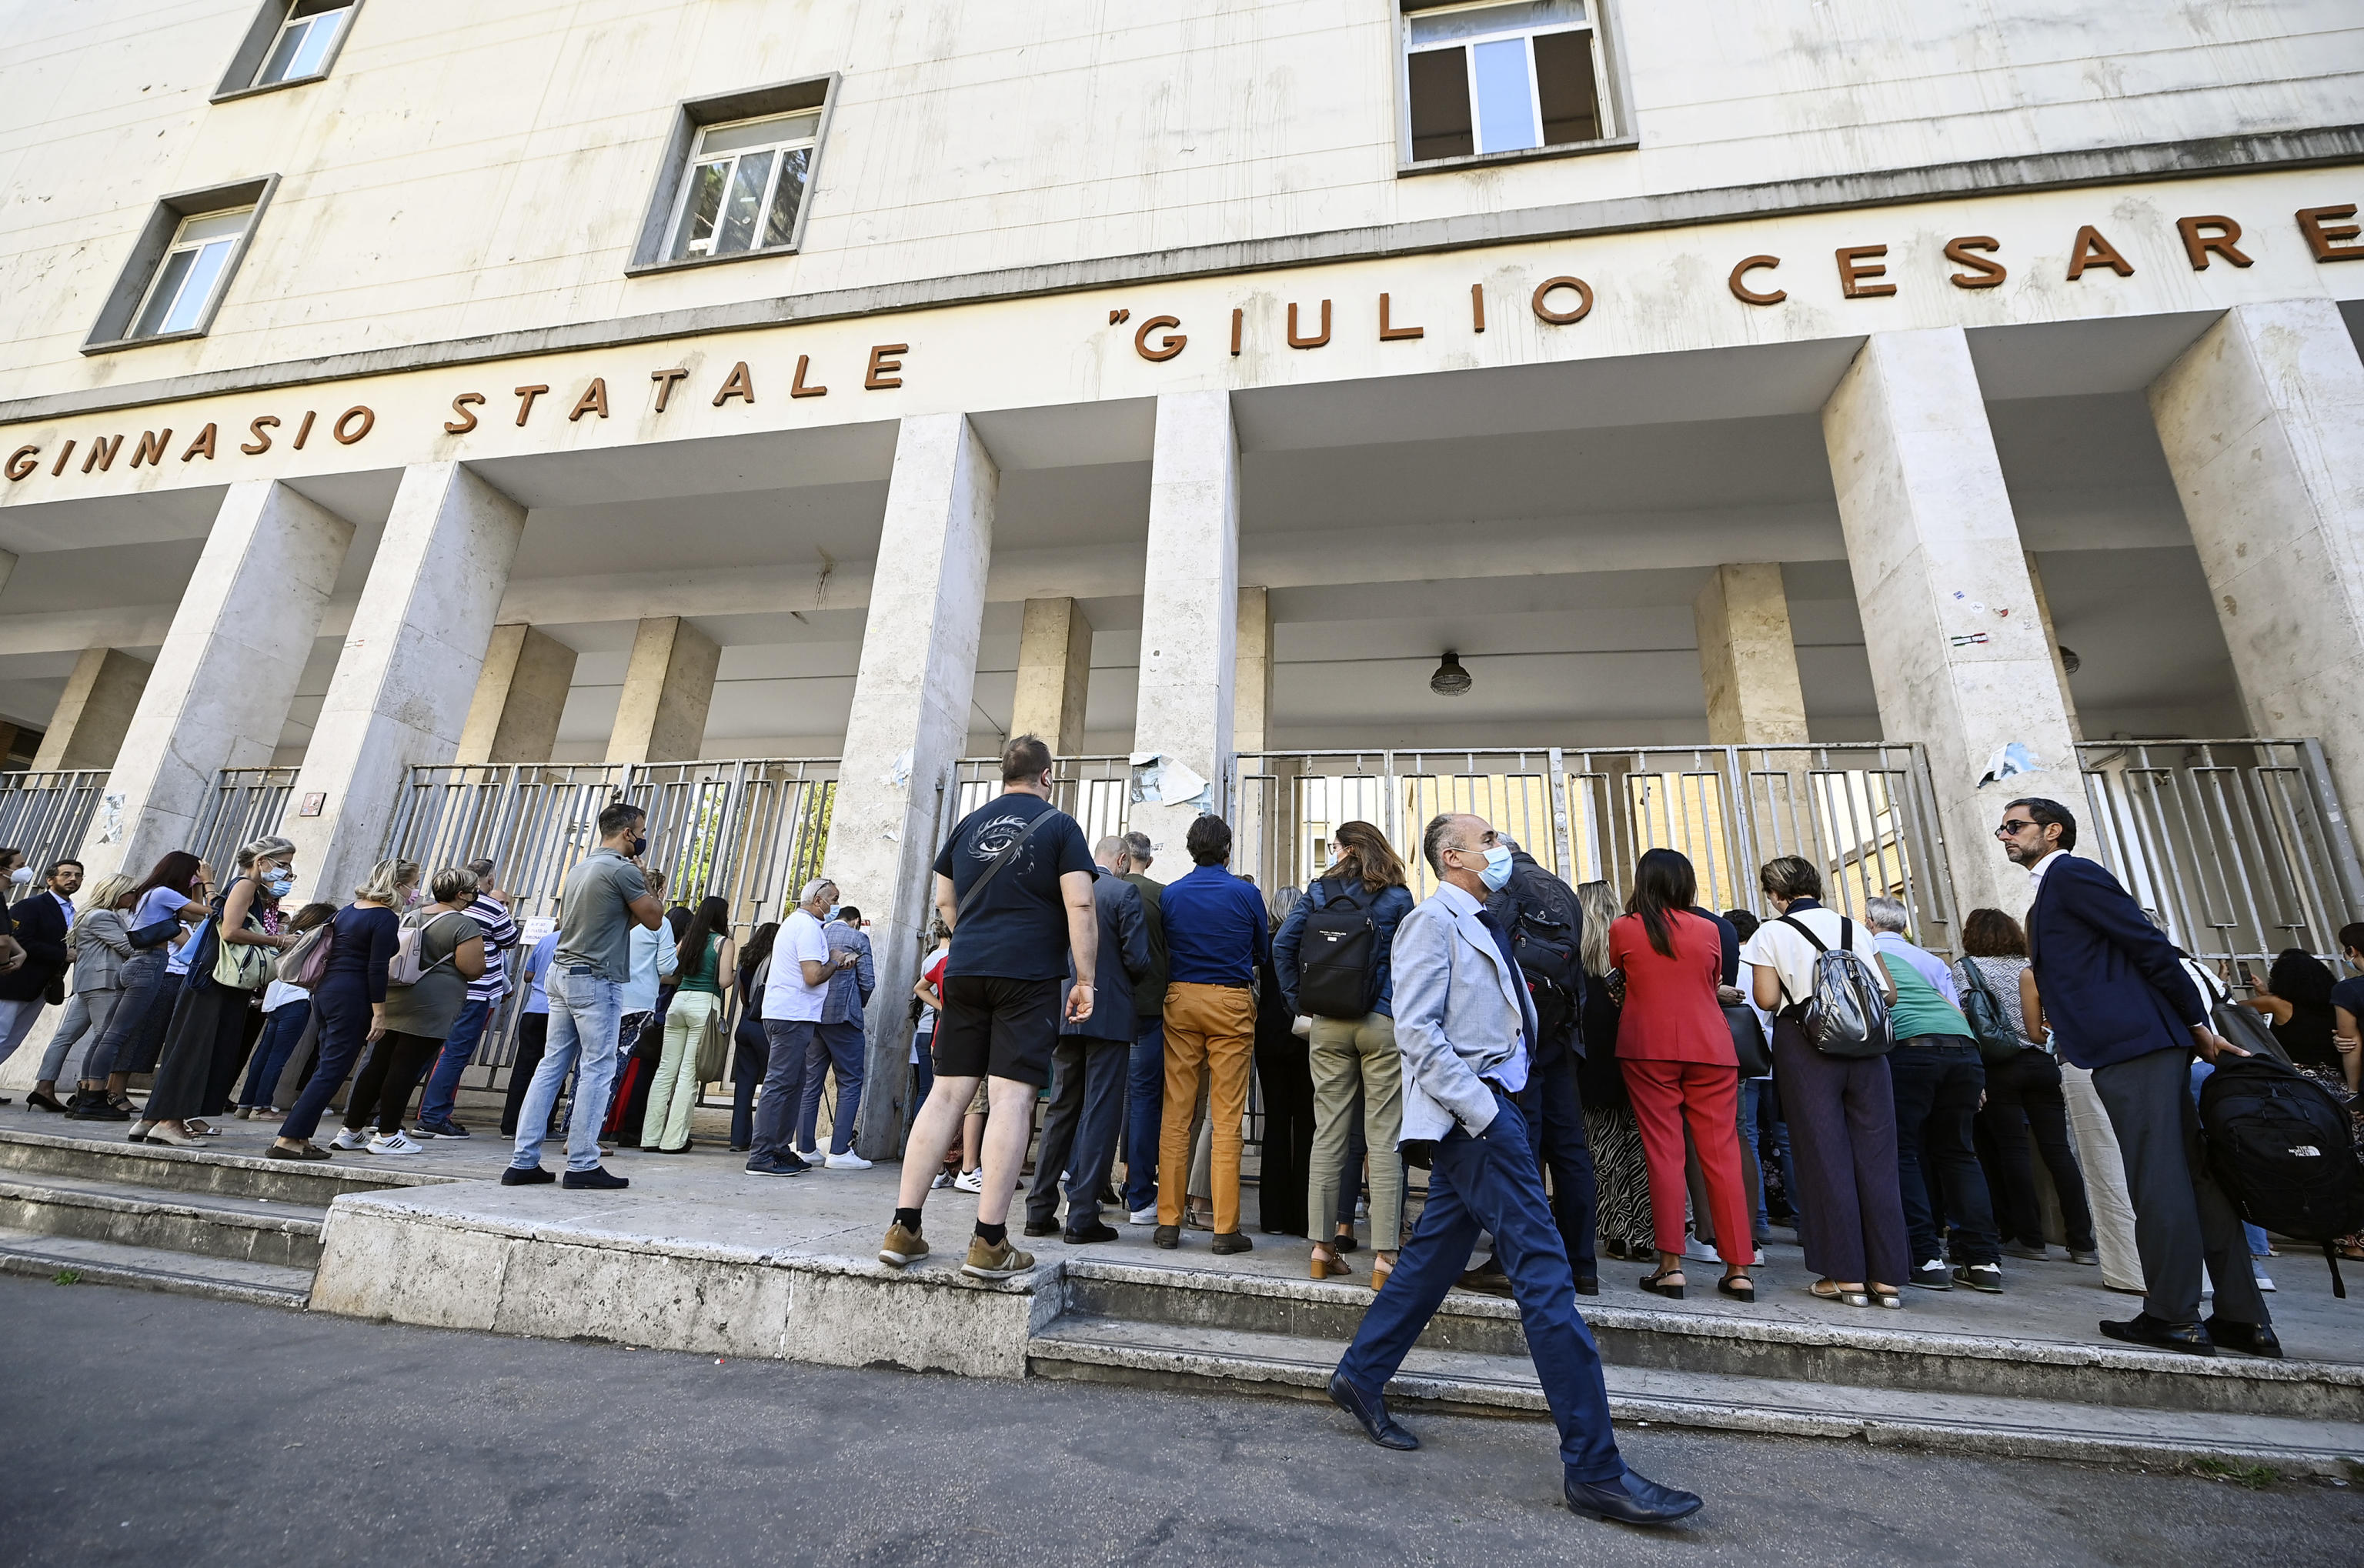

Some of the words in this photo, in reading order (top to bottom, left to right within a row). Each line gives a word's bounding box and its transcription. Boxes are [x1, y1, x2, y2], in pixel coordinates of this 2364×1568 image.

[4, 406, 376, 482] GINNASIO
[444, 344, 909, 437] STATALE
[1729, 204, 2364, 306] CESARE
